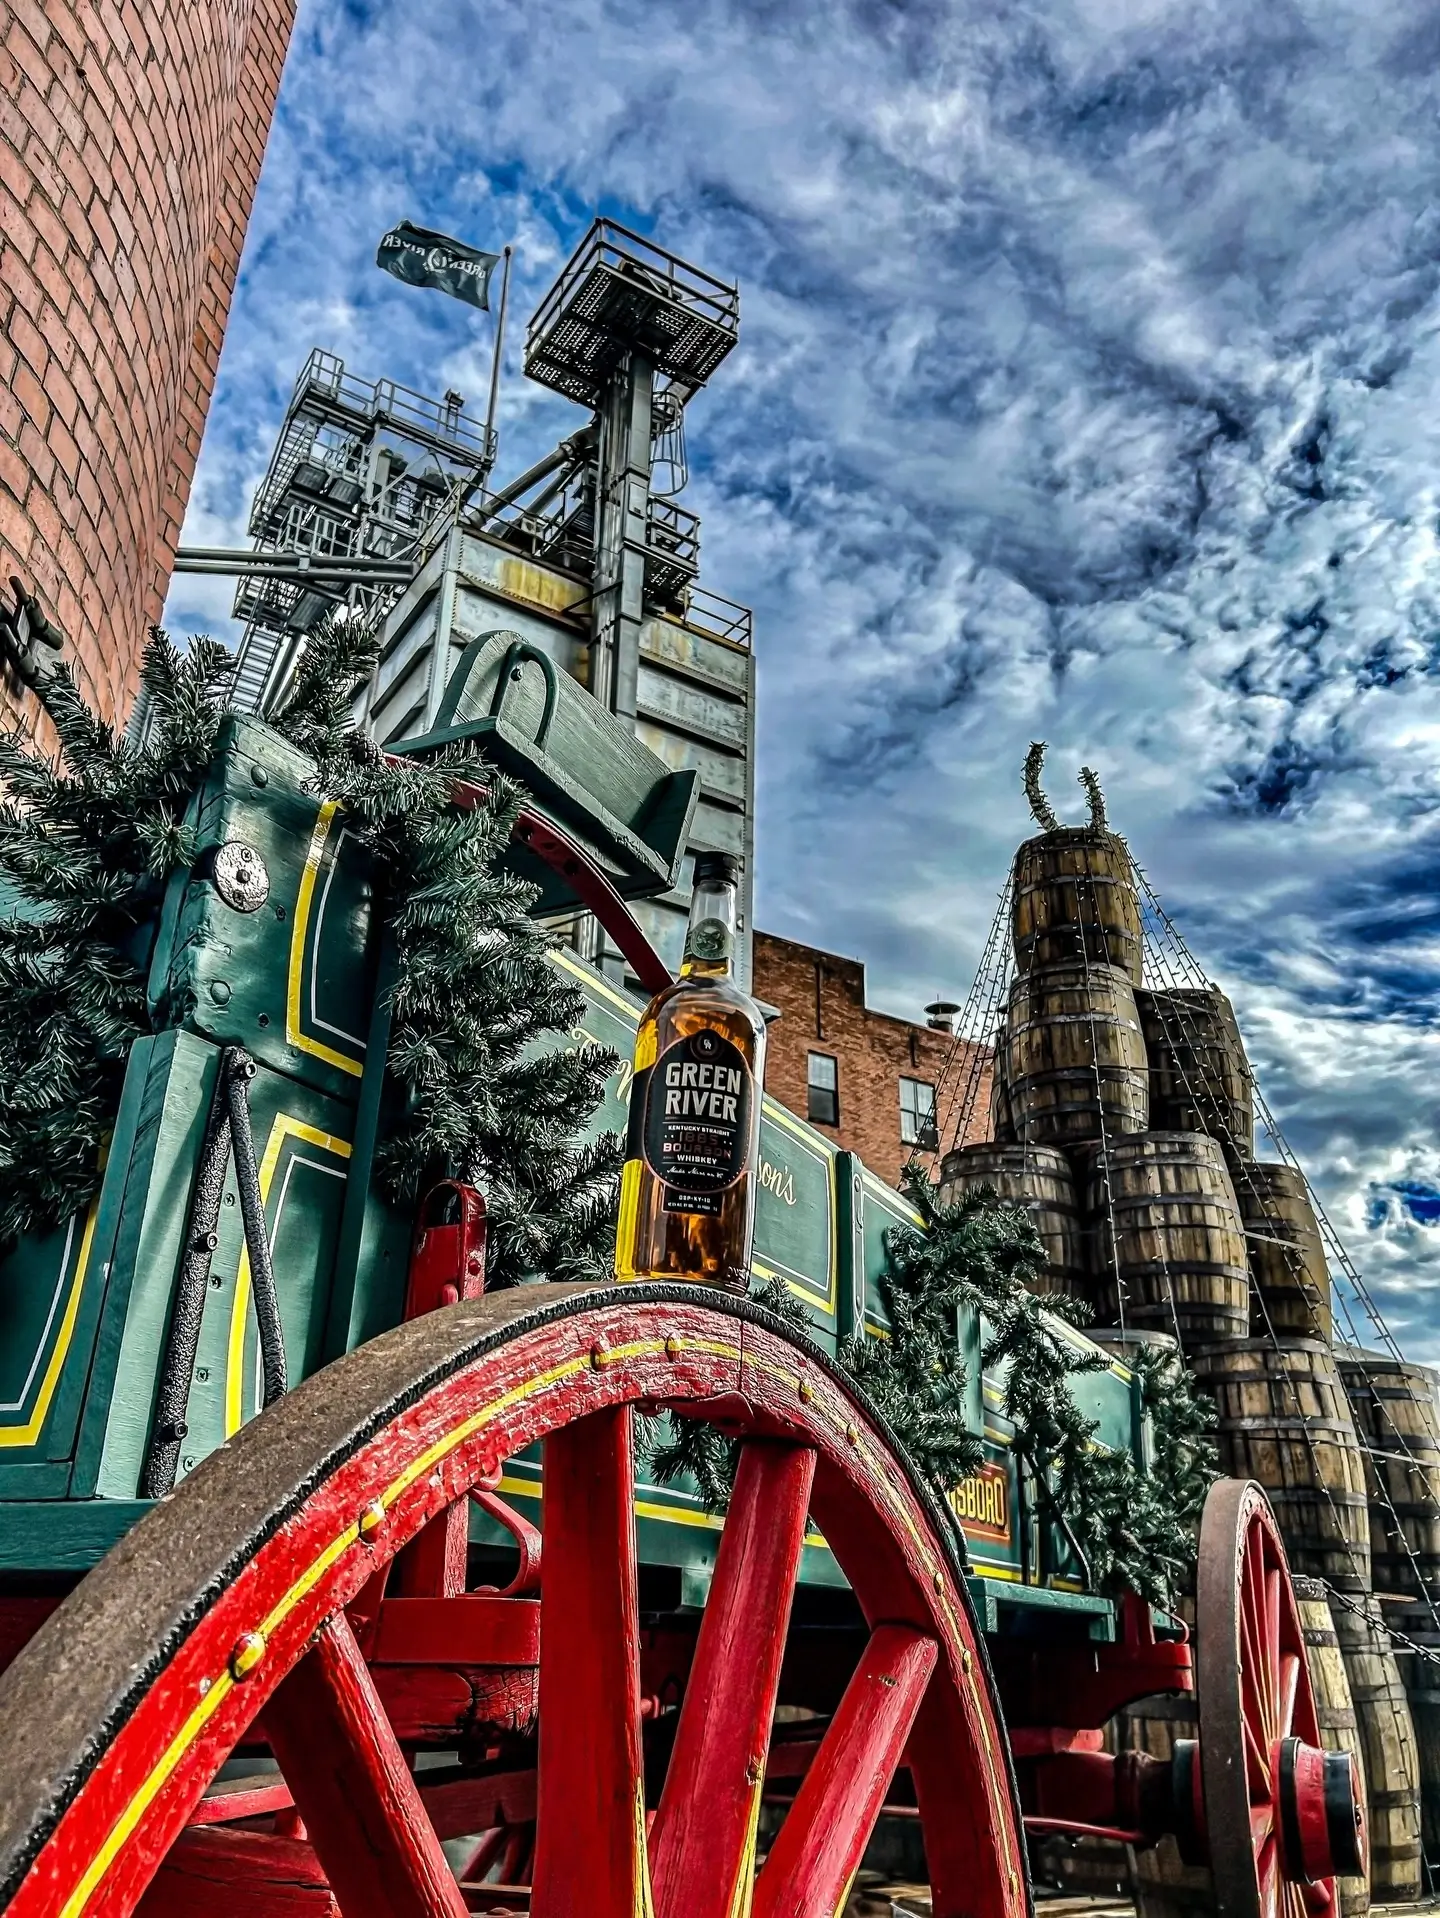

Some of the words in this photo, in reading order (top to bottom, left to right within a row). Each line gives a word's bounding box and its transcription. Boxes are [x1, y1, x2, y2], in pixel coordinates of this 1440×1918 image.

[665, 1062, 742, 1096] GREEN
[665, 1089, 737, 1123] RIVER
[701, 1127, 730, 1137] STRAIGHT
[662, 1142, 732, 1160] BOURBON
[676, 1154, 718, 1165] WHISKEY
